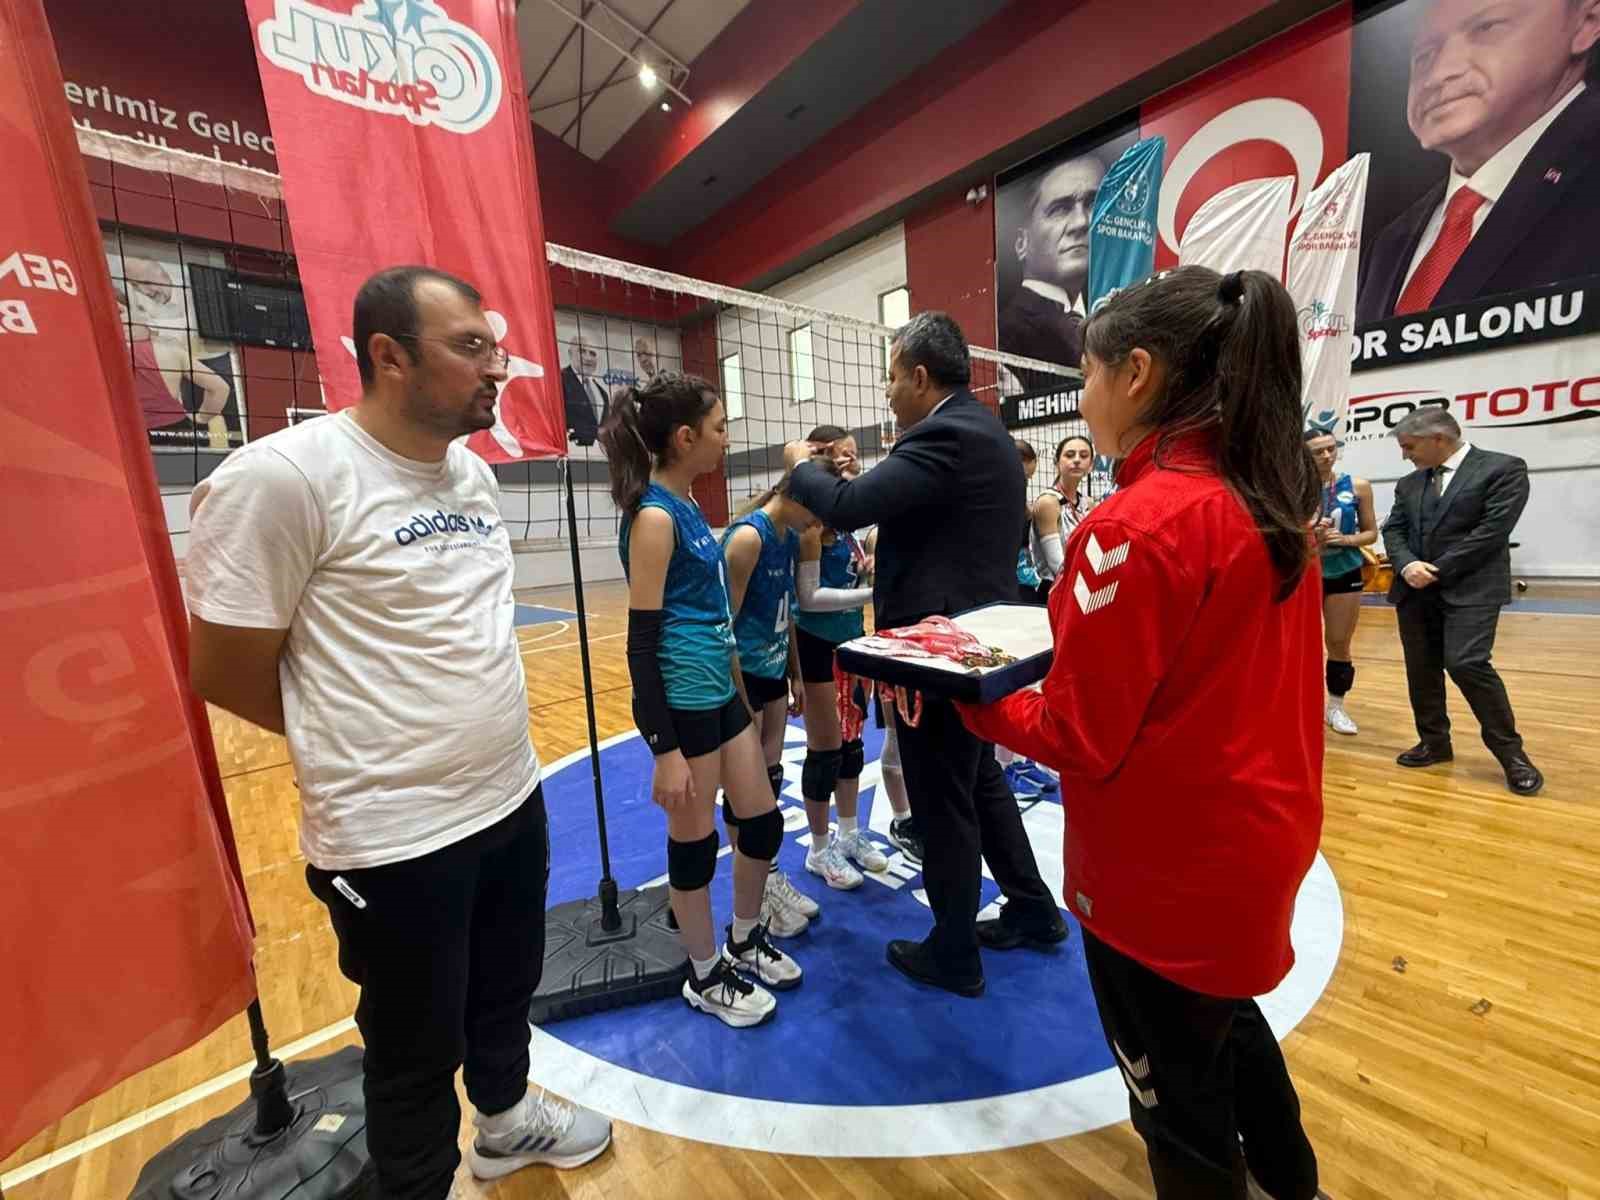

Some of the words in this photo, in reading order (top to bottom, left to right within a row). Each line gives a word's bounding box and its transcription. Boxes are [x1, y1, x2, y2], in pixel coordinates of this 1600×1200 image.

[1400, 291, 1584, 353] SALONU
[1018, 390, 1084, 420] MEHM
[395, 510, 470, 546] adidas
[775, 591, 789, 633] 4
